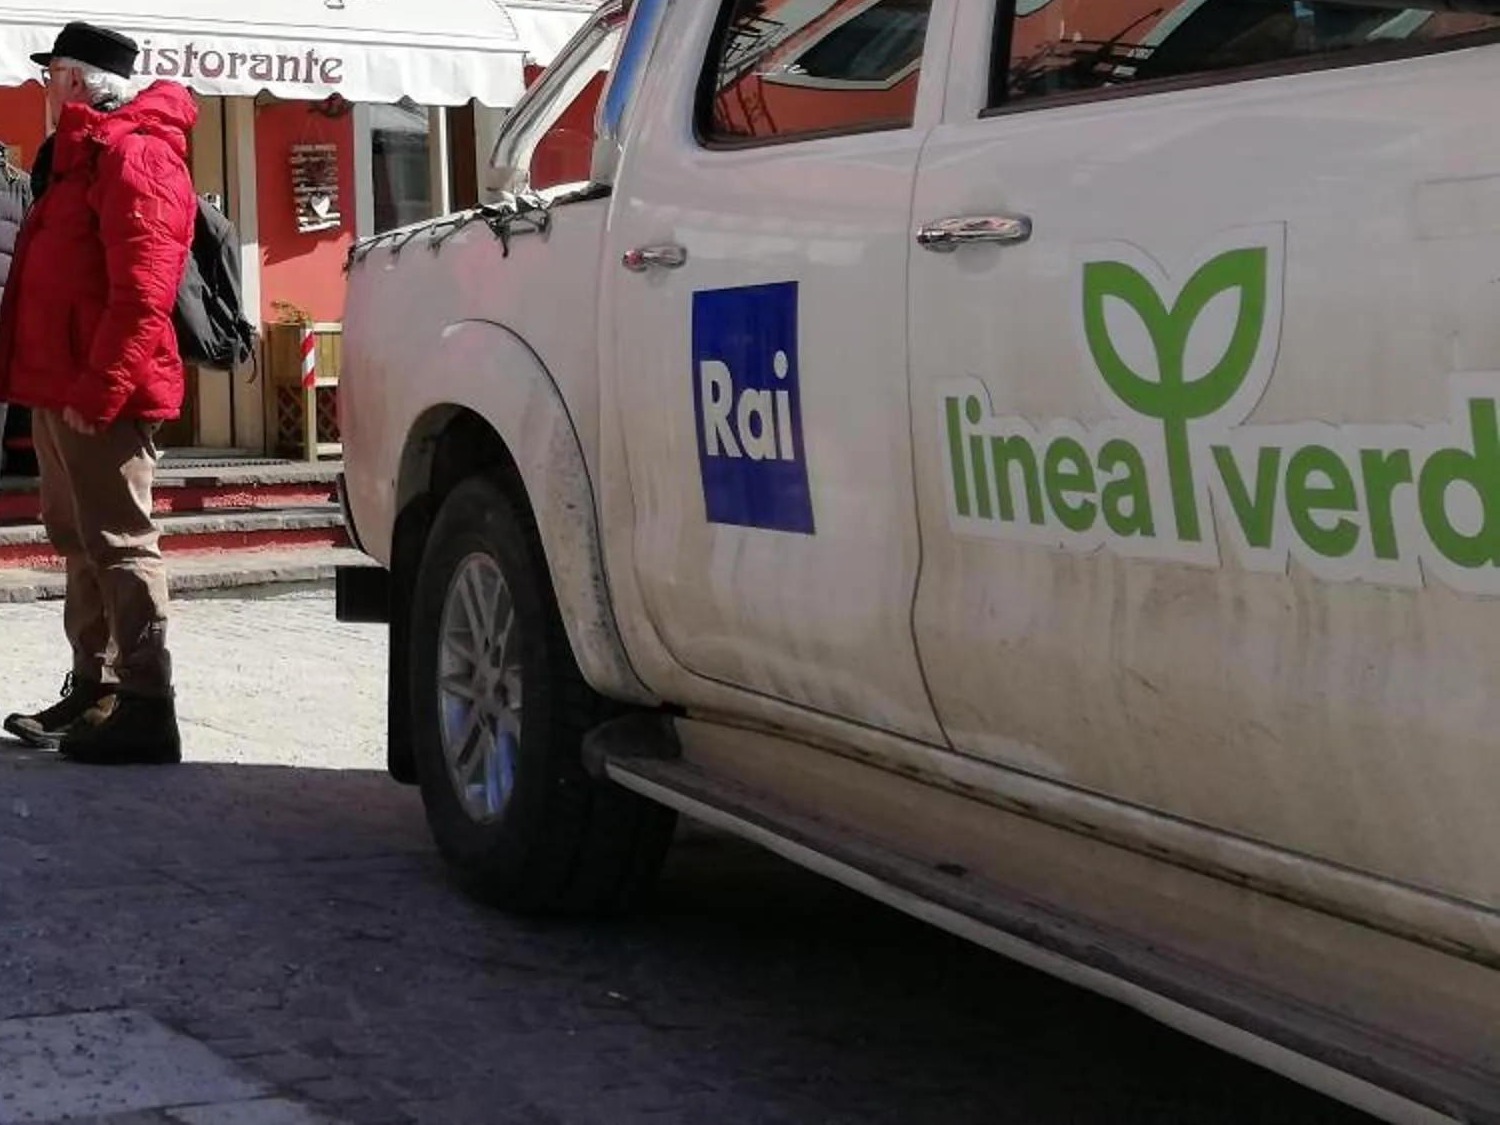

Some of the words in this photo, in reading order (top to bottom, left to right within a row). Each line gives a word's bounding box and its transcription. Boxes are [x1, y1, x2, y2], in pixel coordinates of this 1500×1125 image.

[132, 40, 343, 84] istorante
[700, 350, 795, 460] Rai
[945, 394, 1156, 537] linea
